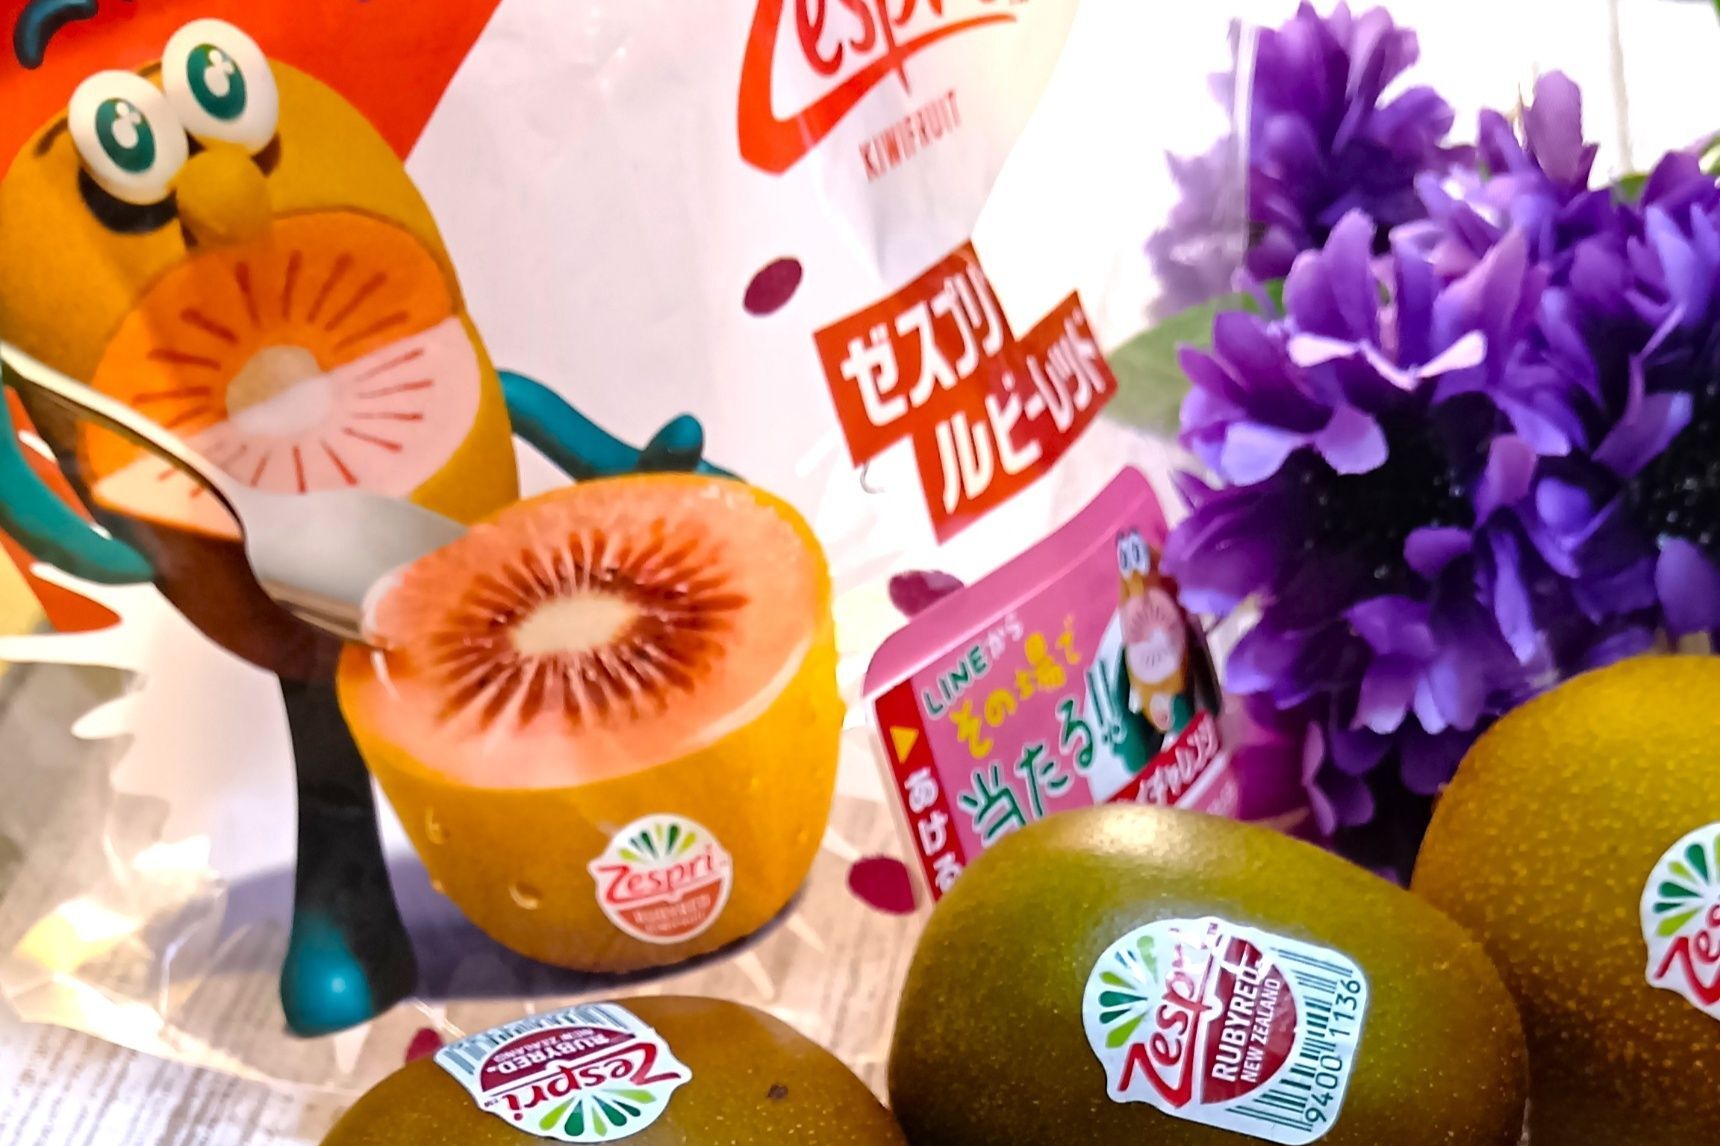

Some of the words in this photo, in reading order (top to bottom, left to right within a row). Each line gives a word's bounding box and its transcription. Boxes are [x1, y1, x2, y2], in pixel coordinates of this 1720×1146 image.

[858, 89, 961, 182] KIWIFRUIT
[840, 263, 1003, 427] ゼスプリ
[935, 308, 1106, 514] ルビーレッド
[598, 844, 714, 906] Zespri
[1251, 978, 1280, 1048] ZEALAND
[1305, 1054, 1343, 1123] 9400
[1329, 979, 1361, 1037] 1136
[490, 1042, 682, 1121] Zespri
[1241, 1048, 1263, 1083] NEW
